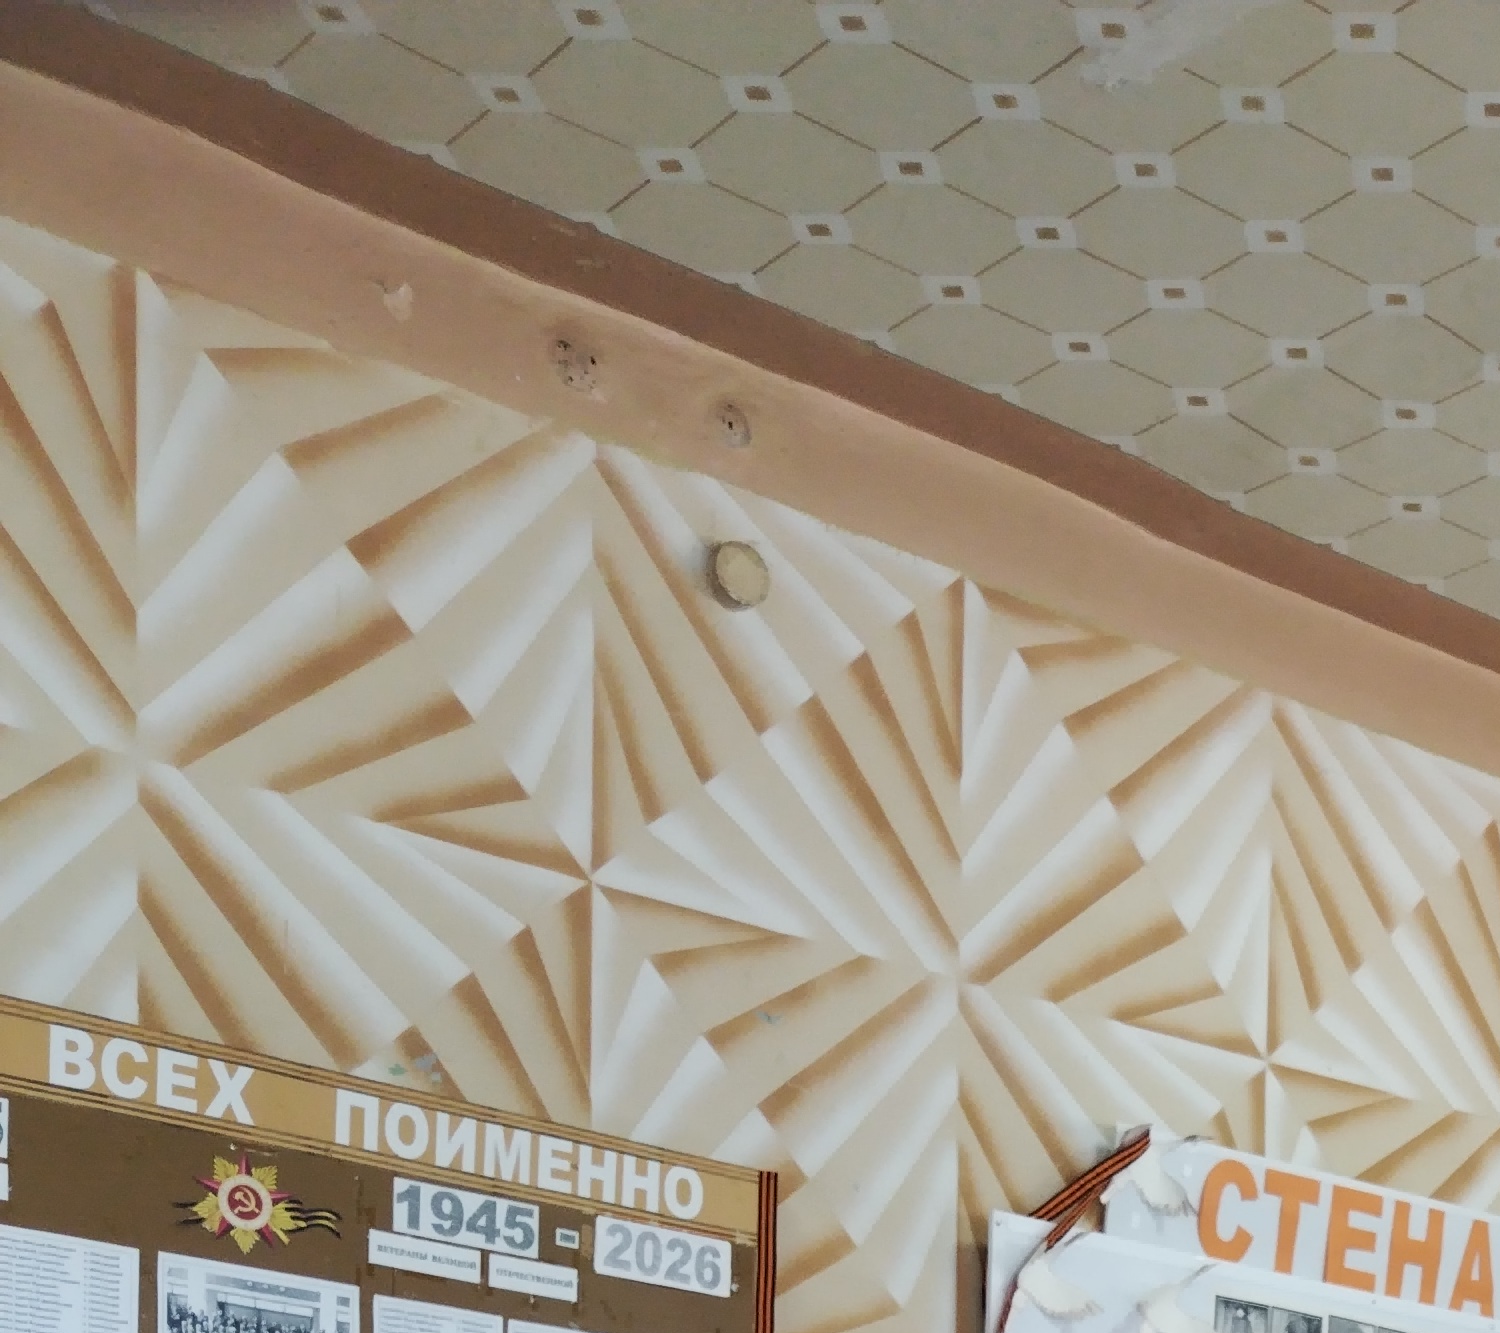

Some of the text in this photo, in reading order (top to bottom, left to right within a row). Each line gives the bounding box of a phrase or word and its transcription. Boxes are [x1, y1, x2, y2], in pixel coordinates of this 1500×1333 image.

[49, 1023, 703, 1220] ВСЕХ ПОИМЕННО
[396, 1185, 536, 1250] 1945
[603, 1223, 722, 1291] 2026
[1197, 1159, 1495, 1318] СТЕНА
